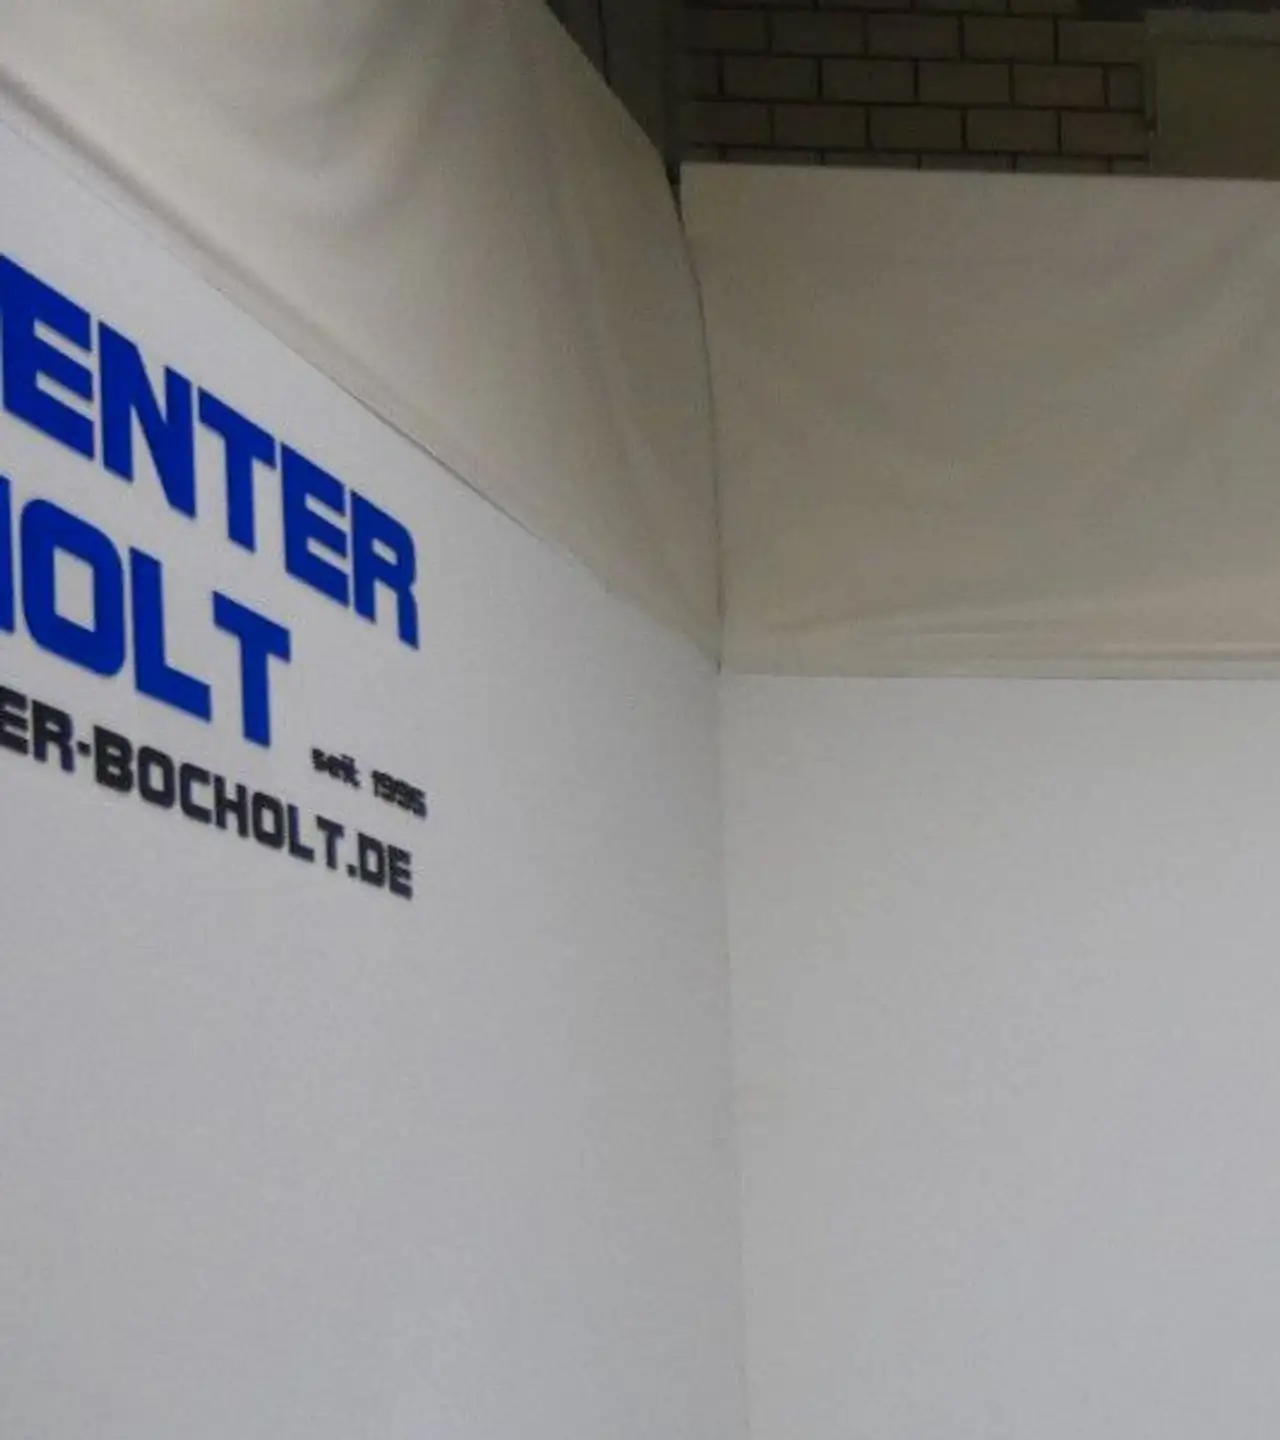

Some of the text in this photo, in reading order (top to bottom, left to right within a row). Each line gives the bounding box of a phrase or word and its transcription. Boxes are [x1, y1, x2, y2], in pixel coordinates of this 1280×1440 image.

[0, 256, 420, 650] ENTER
[0, 474, 292, 747] OLT
[310, 747, 428, 818] seit 1995
